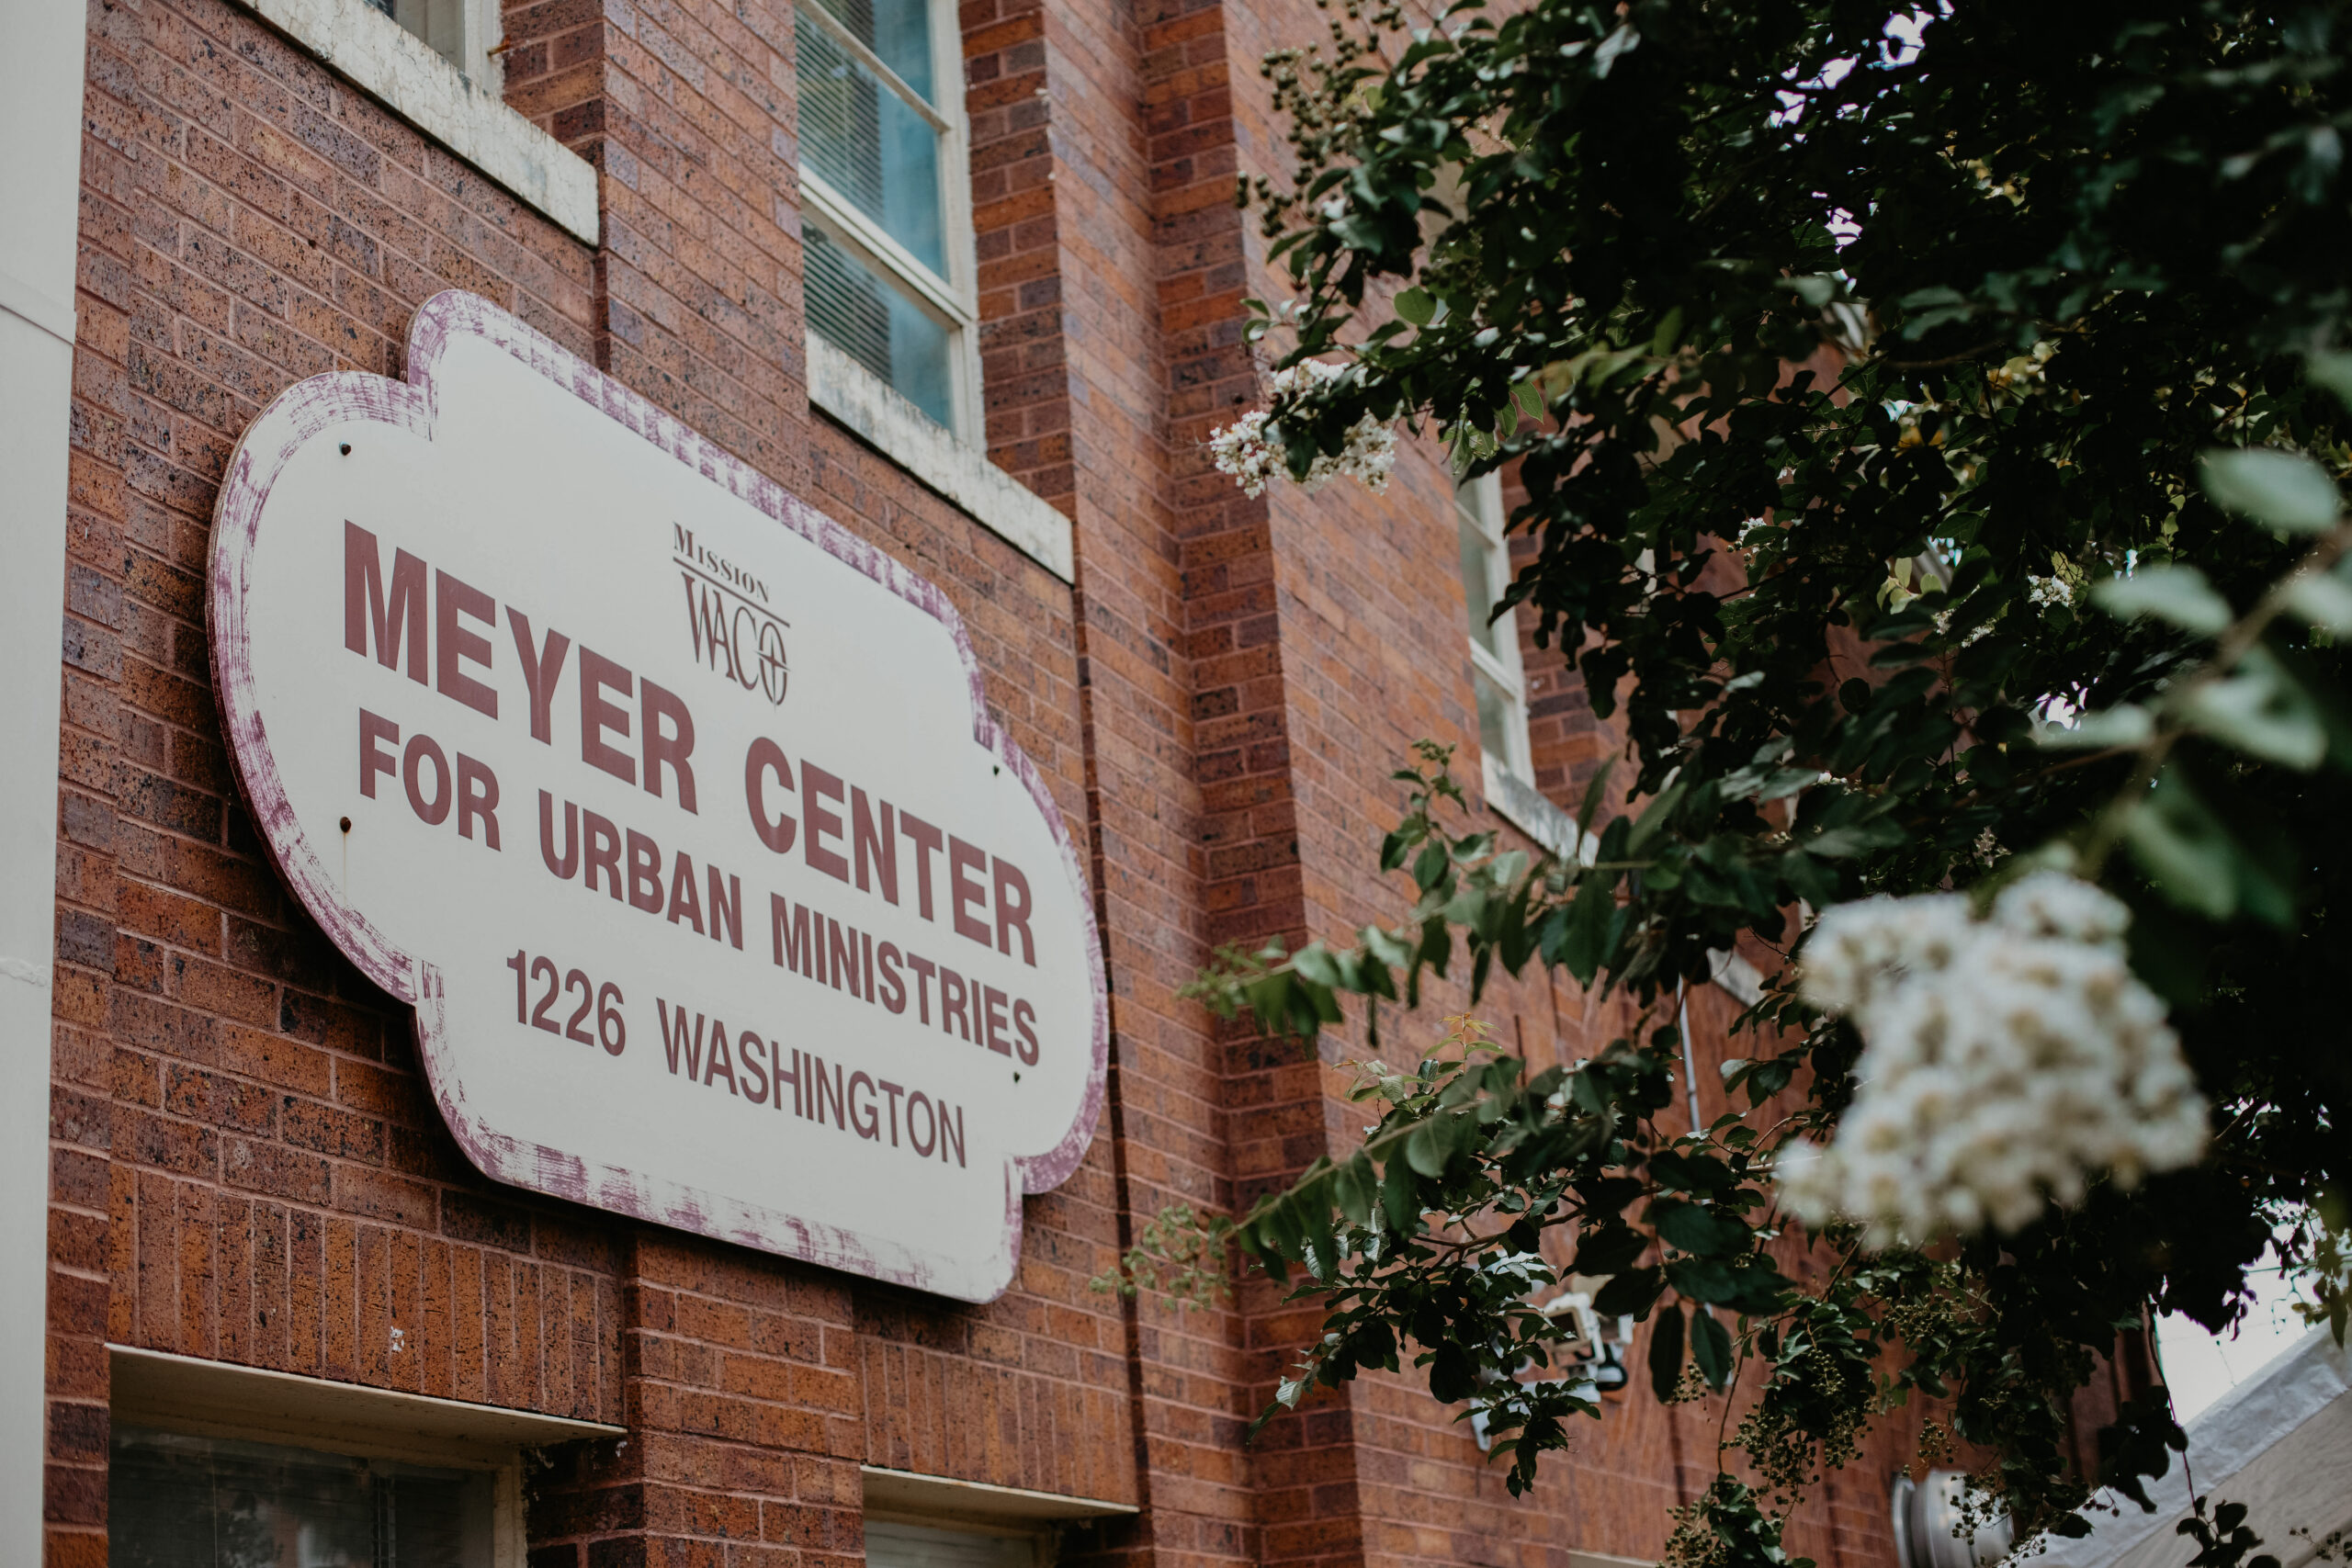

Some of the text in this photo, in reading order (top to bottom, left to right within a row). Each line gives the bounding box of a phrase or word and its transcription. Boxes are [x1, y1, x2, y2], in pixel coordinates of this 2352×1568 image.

[344, 518, 1037, 969] MEYER CENTER
[681, 570, 790, 708] WACO
[358, 706, 1040, 1067] FOR URBAN MINISTRIES
[506, 948, 967, 1169] 1226 WASHINGTON
